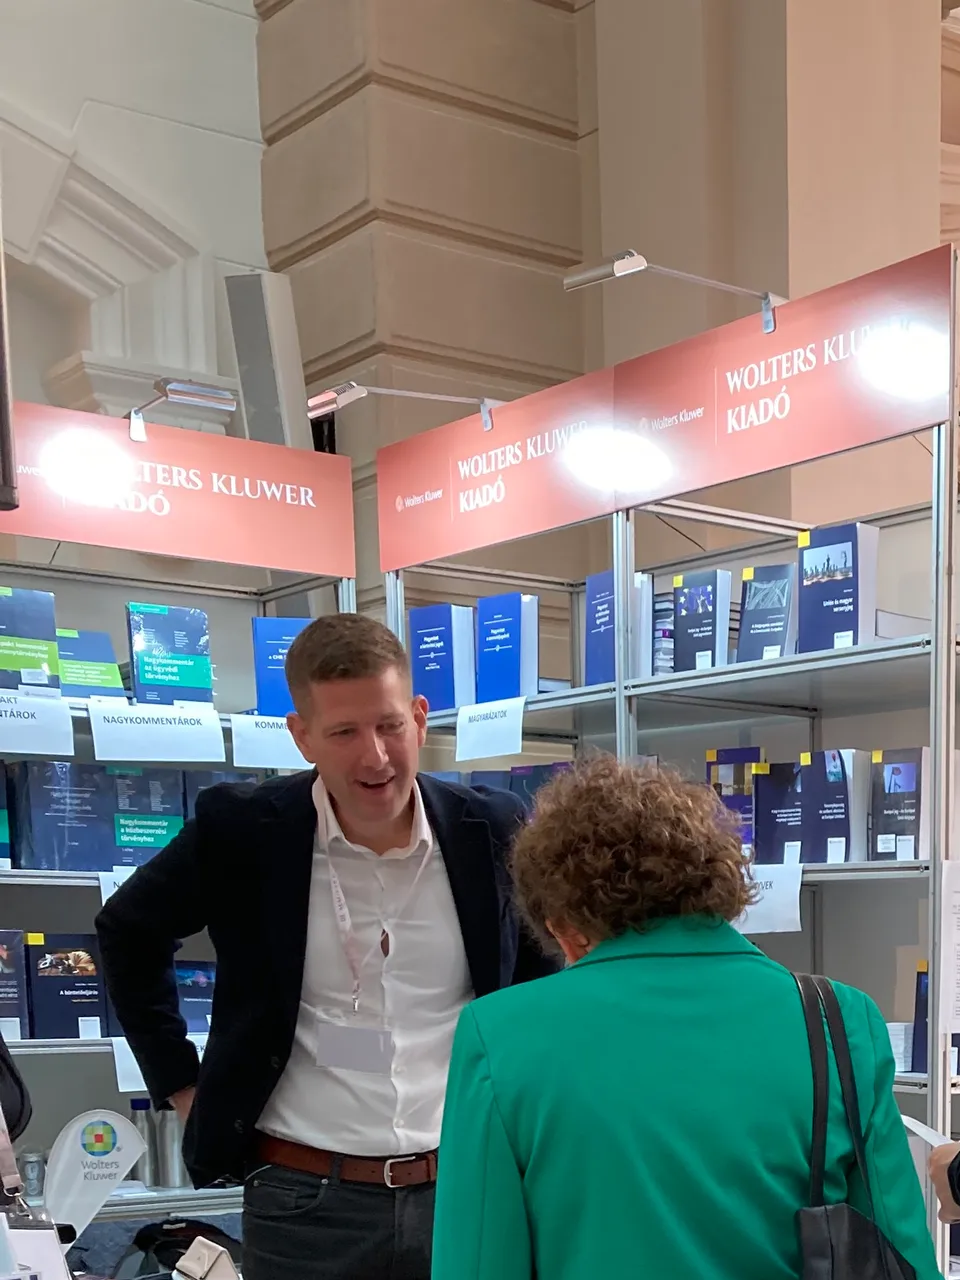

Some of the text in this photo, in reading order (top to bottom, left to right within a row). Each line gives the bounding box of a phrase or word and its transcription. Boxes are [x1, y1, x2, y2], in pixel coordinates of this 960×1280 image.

[725, 344, 817, 395] WOLTERS
[651, 406, 705, 431] Wolters Kluwer
[726, 385, 791, 434] KIADÓ
[457, 441, 523, 481] WOLTERS
[211, 472, 316, 508] KLUWER
[404, 488, 443, 508] Wolters Kluwer
[459, 474, 506, 513] KIADÓ
[0, 708, 37, 720] TÁROK
[102, 715, 203, 727] NAGYKOMMENTÁROK
[254, 720, 288, 731] KOMME
[81, 1160, 120, 1170] Wolters
[83, 1171, 118, 1181] Kluwer
